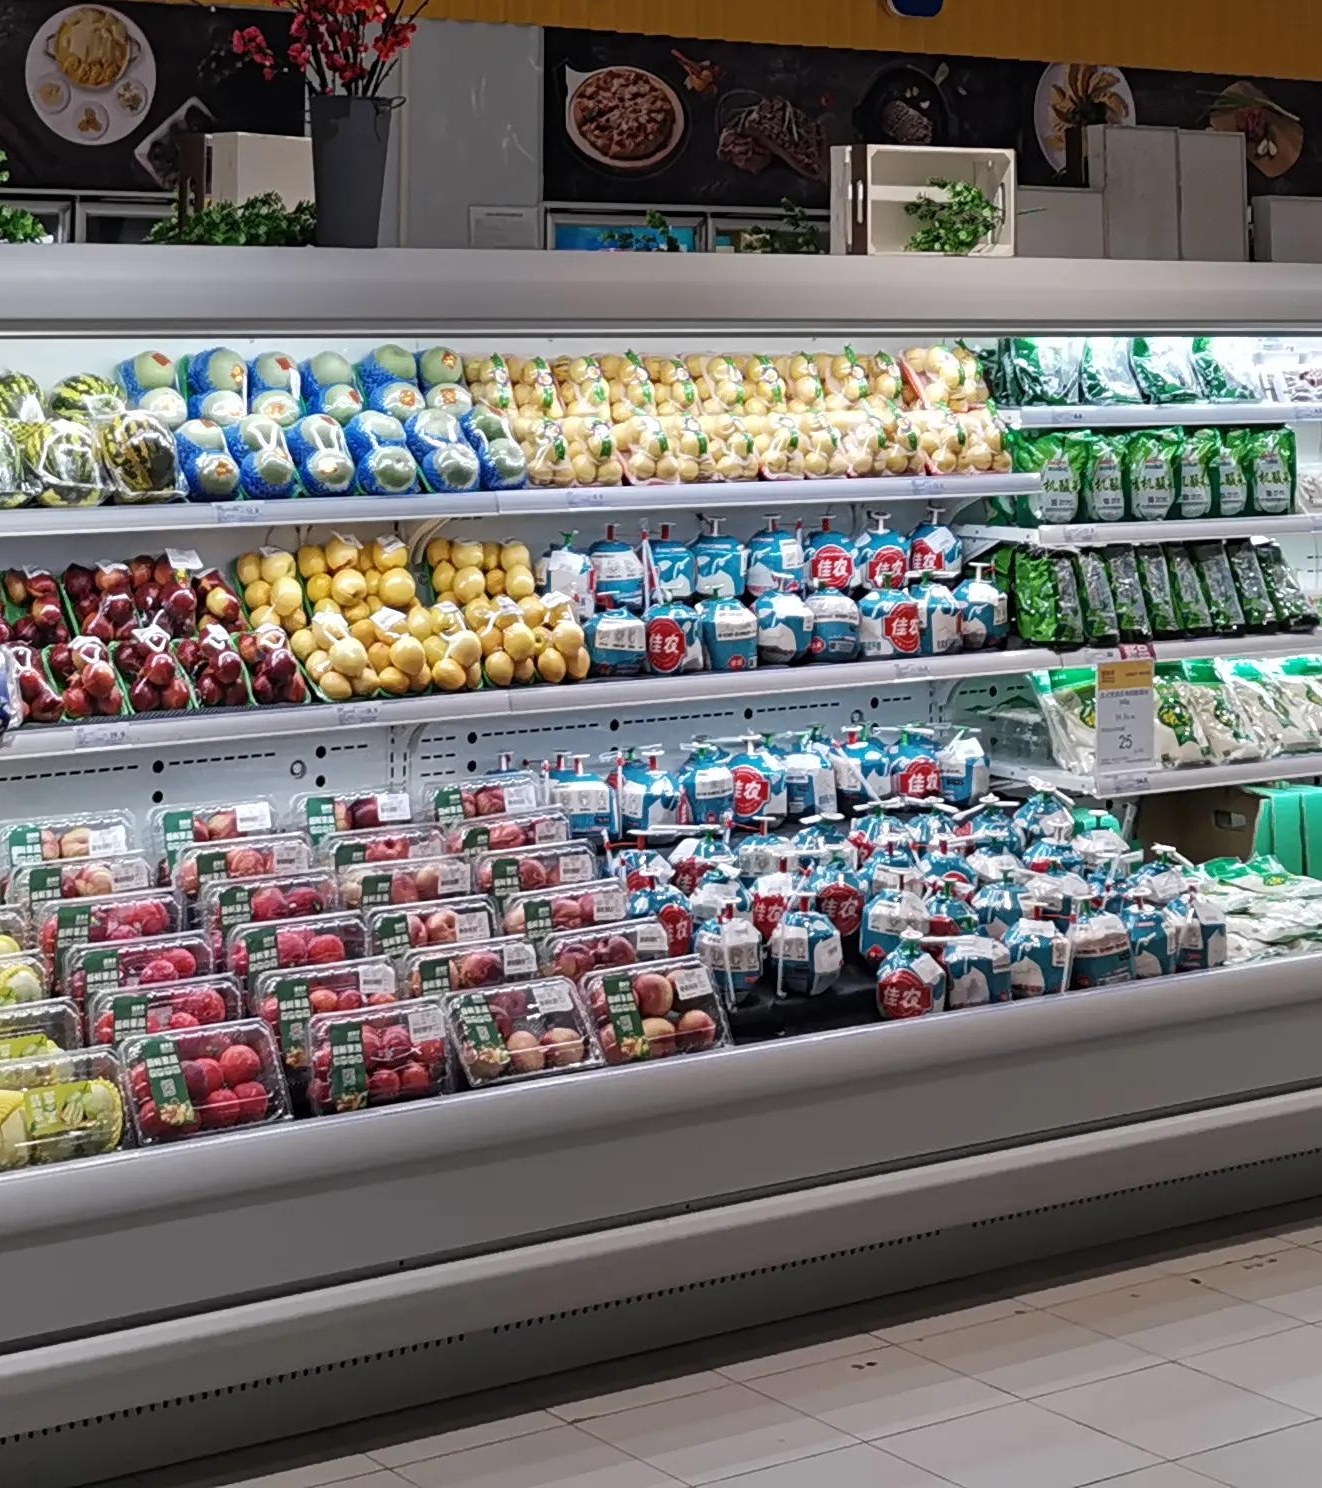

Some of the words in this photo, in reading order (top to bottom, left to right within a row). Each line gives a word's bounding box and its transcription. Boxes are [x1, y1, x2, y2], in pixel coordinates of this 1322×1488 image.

[817, 559, 847, 577] 佳农
[876, 560, 902, 576] 佳农
[649, 633, 679, 654] 佳农
[1118, 735, 1133, 750] 25
[908, 772, 939, 794] 佳农
[754, 903, 783, 923] 佳农
[821, 897, 859, 918] 佳农
[883, 986, 922, 1008] 佳农
